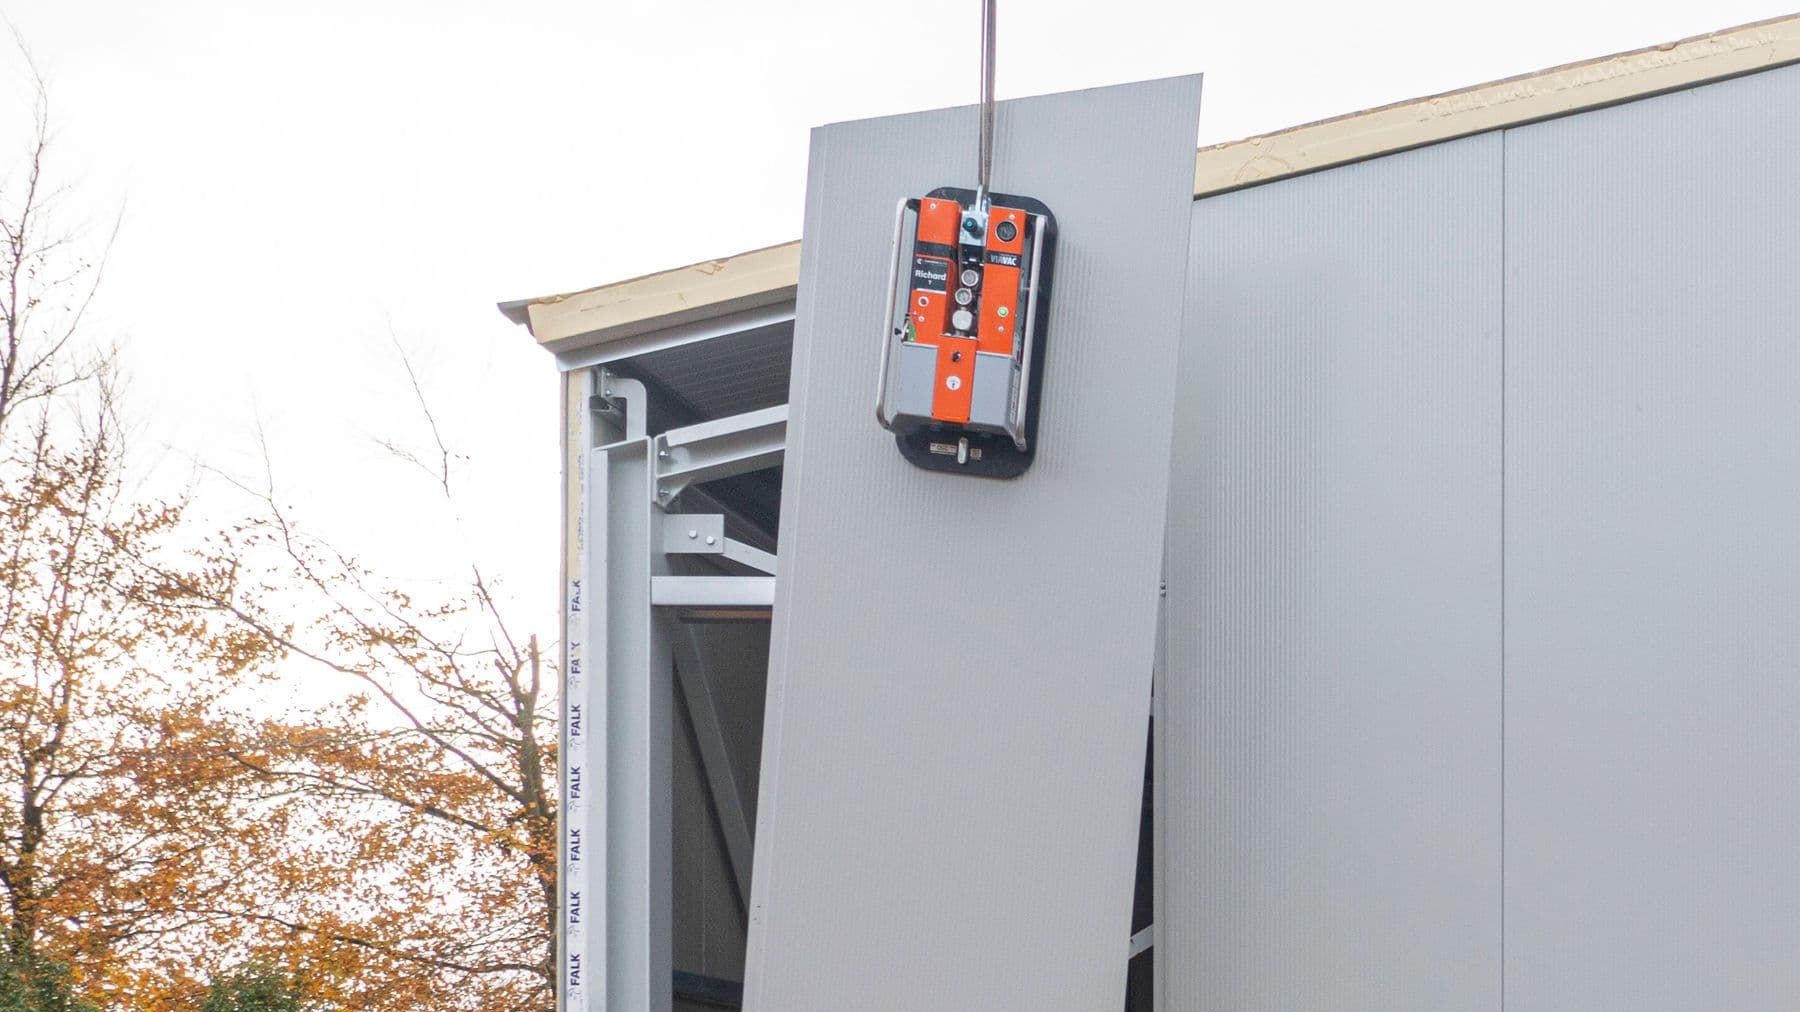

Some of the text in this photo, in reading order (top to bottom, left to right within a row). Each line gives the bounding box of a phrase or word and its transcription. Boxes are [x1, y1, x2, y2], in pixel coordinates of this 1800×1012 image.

[914, 269, 947, 281] Richard
[570, 641, 581, 674] FAK
[570, 704, 581, 736] FALK
[570, 767, 581, 799] FALK
[570, 829, 581, 861] FALK
[570, 891, 581, 923] FALK
[570, 953, 581, 986] FALK
